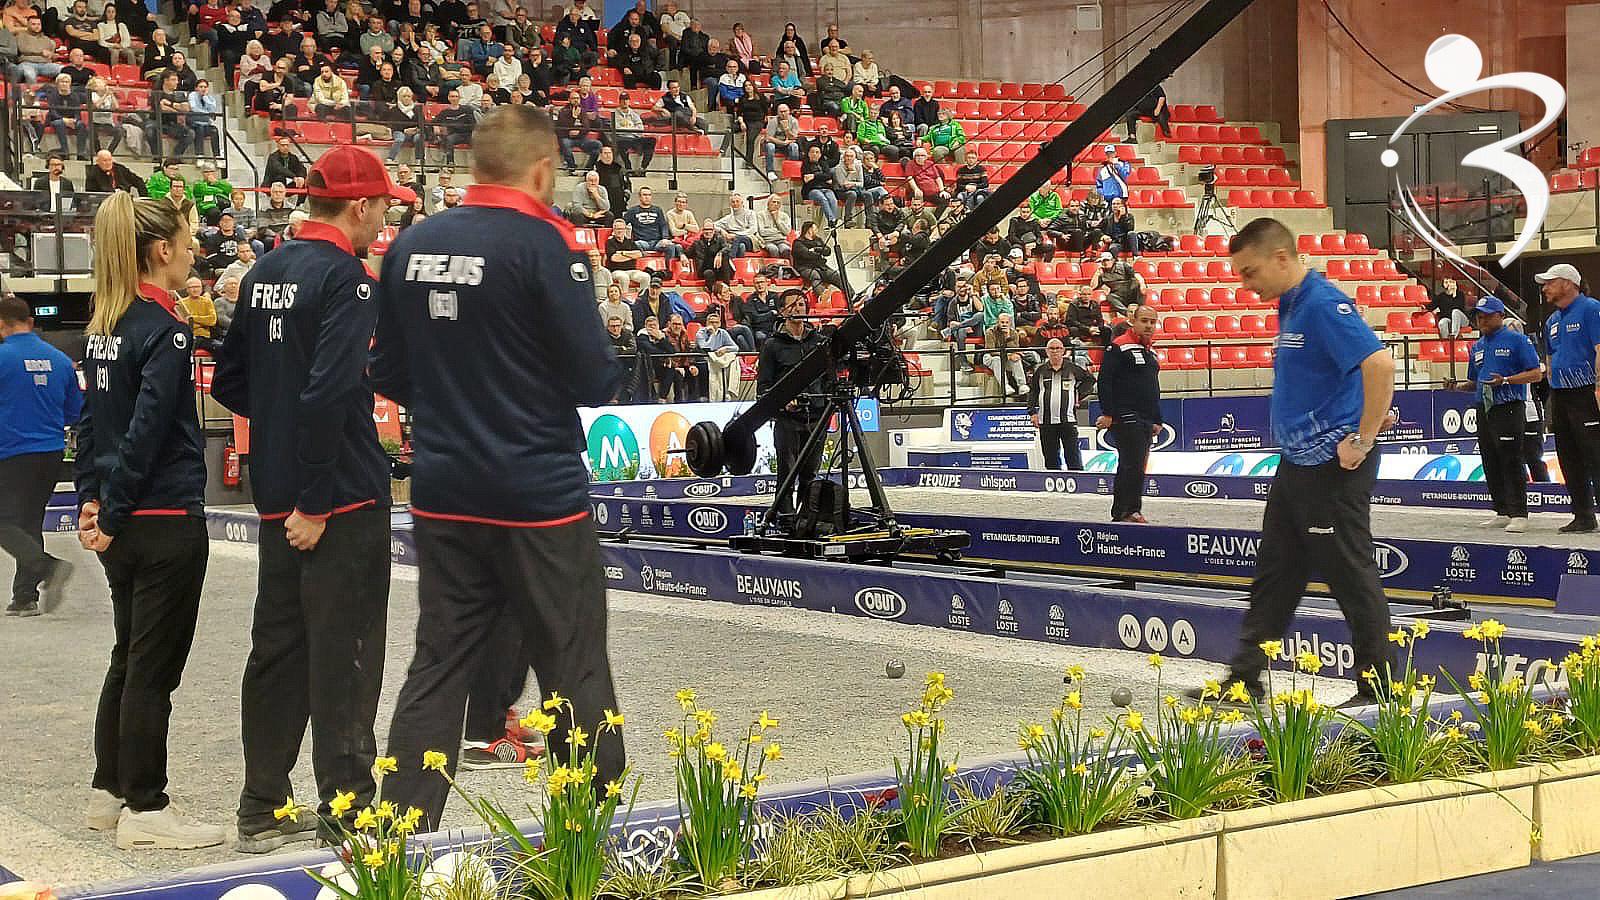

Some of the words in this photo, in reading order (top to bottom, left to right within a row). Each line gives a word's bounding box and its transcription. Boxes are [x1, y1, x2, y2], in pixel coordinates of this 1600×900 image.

[251, 283, 298, 310] FREJUS
[86, 334, 122, 361] FREJUS
[981, 472, 1017, 489] uhlsport
[695, 511, 720, 527] OBUT
[1097, 531, 1119, 542] Région
[1097, 544, 1166, 558] Hauts-de-France
[1445, 568, 1476, 578] LOSTE
[1501, 571, 1535, 583] LOSTE
[655, 580, 707, 596] Hauts-de-France
[736, 574, 803, 599] BEAUVAIS
[865, 591, 896, 612] OBUT
[948, 615, 971, 626] LOSTE
[996, 620, 1019, 632] LOSTE
[1045, 626, 1070, 638] LOSTE
[1281, 631, 1355, 676] uhlsp
